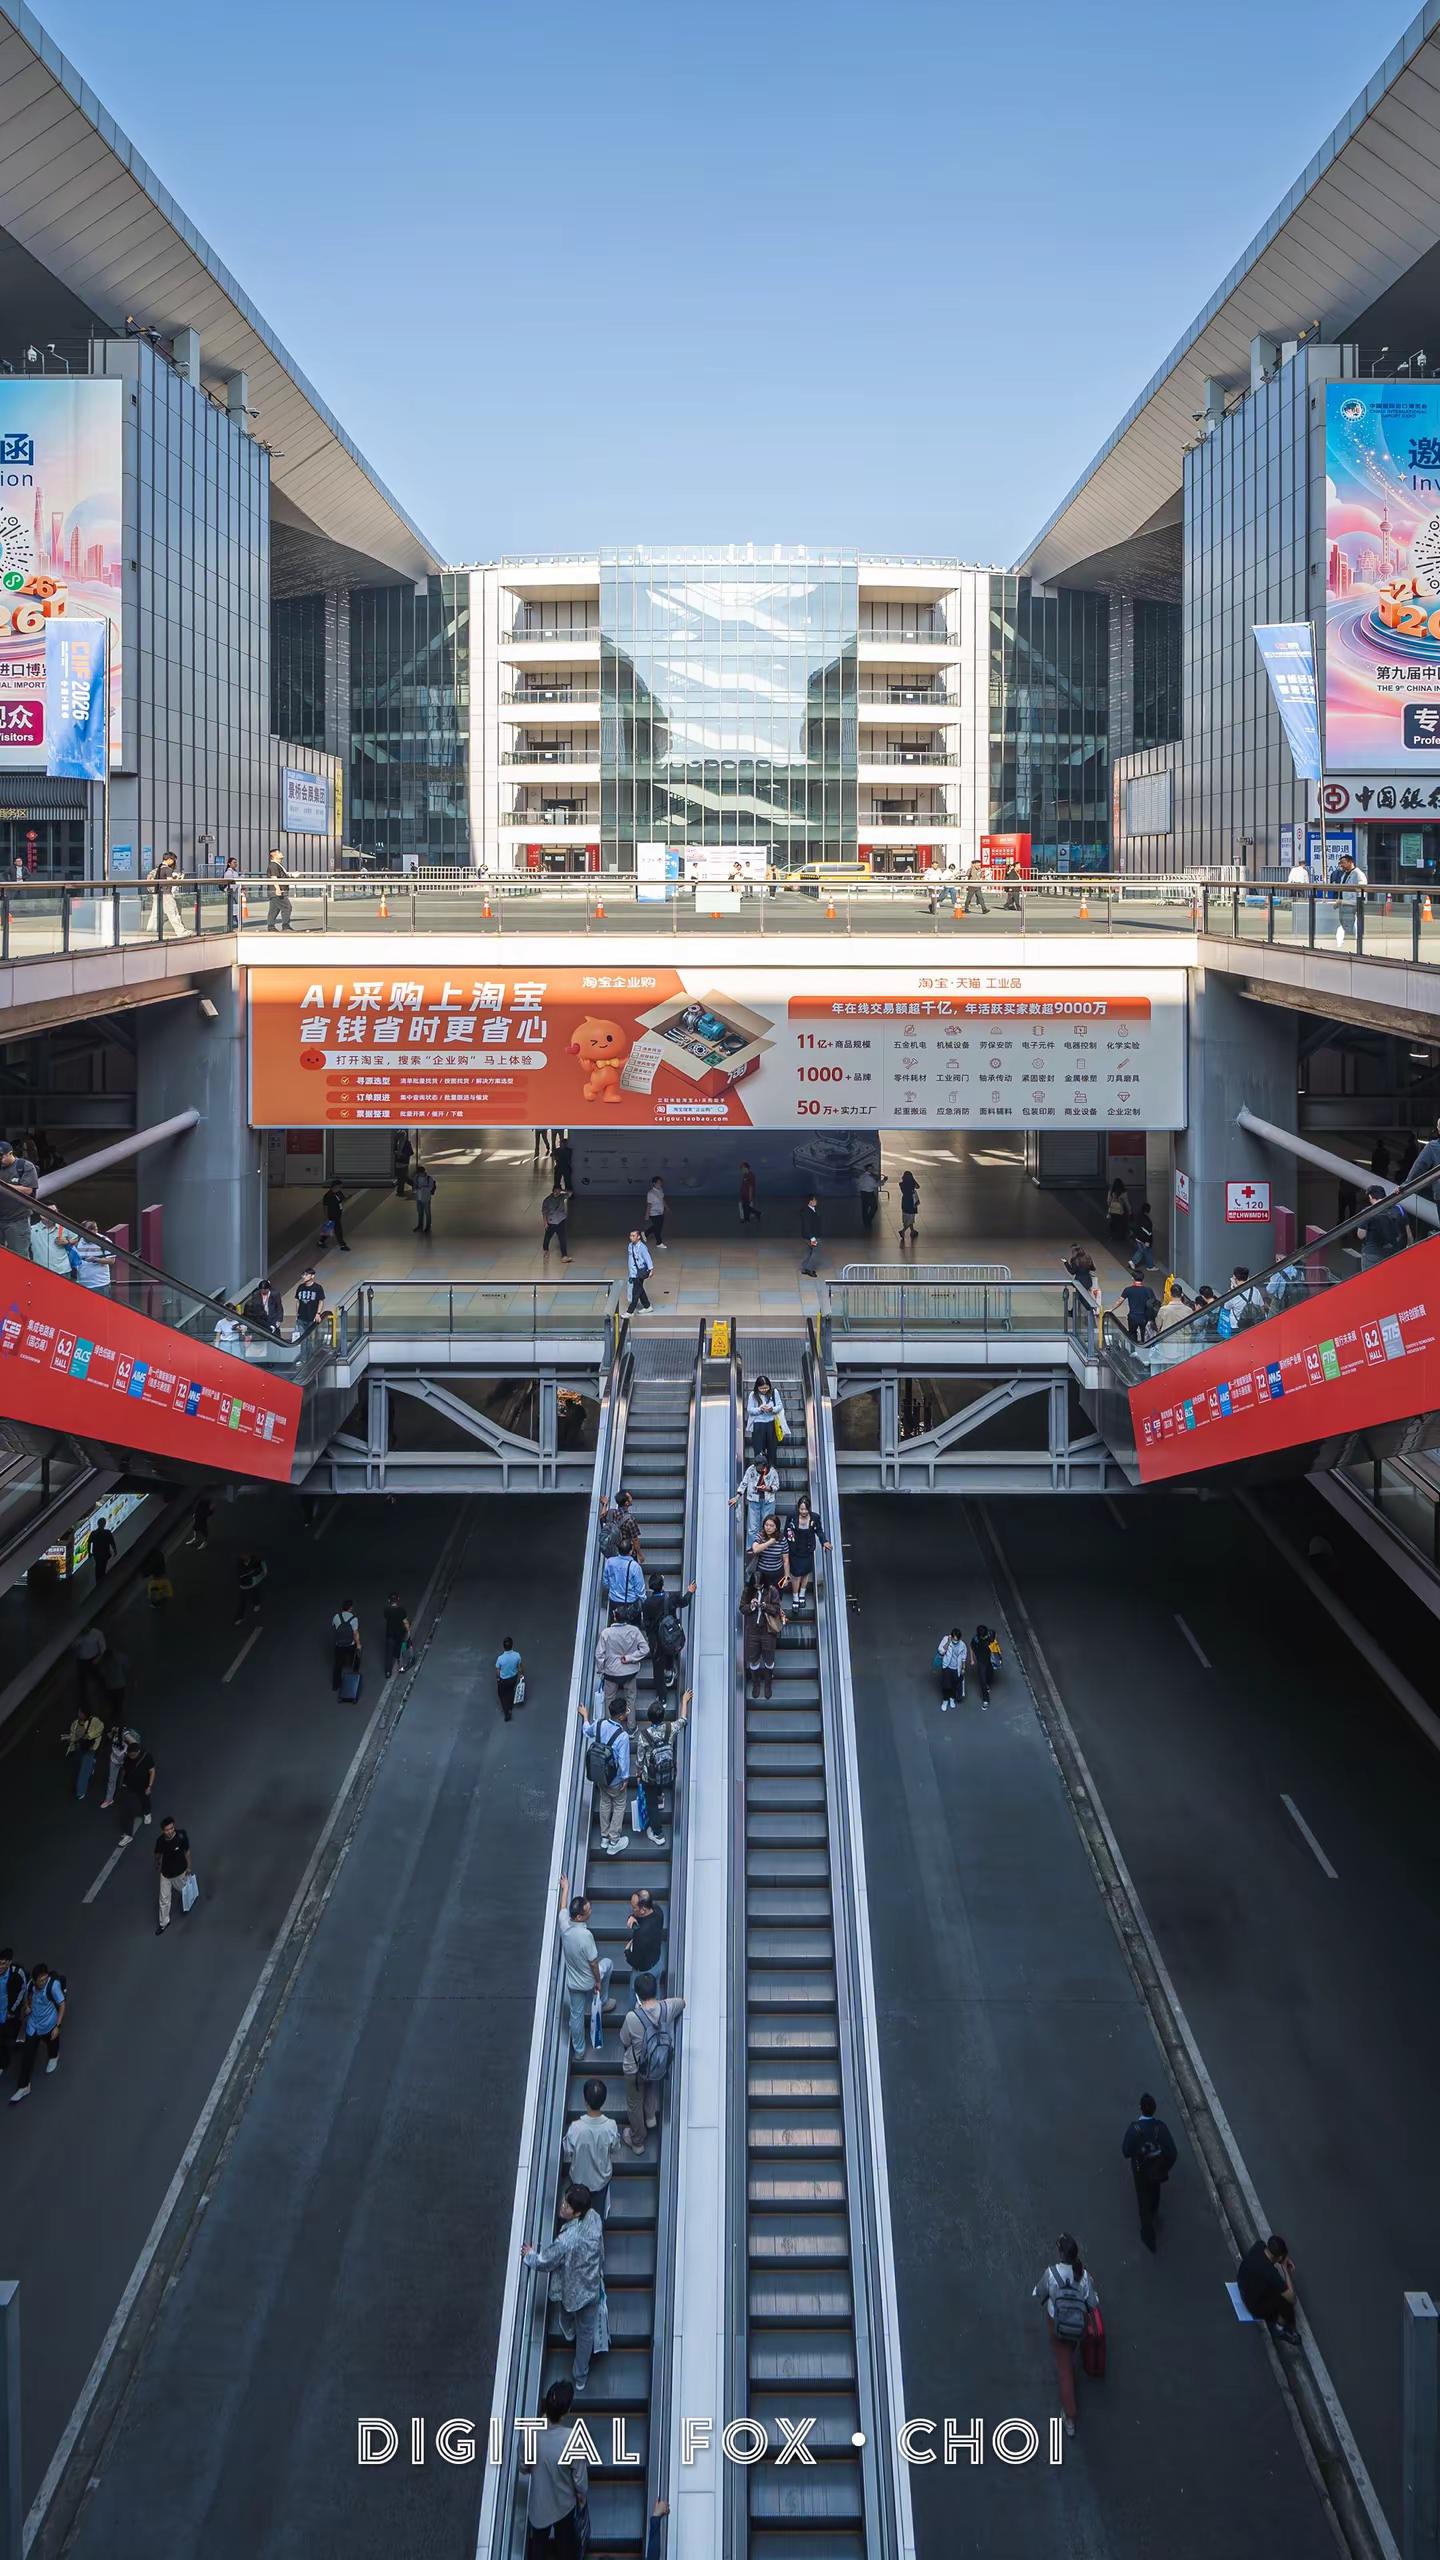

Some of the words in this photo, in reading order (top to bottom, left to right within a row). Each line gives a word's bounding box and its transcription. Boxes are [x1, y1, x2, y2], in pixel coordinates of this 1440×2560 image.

[0, 434, 34, 466] 函
[1408, 437, 1440, 469] 邀
[1377, 666, 1440, 680] 第九届中
[1377, 684, 1393, 692] THE
[1406, 684, 1432, 692] CHINA
[72, 681, 90, 721] 2026
[1414, 708, 1440, 732] 专
[0, 732, 34, 742] isitors
[582, 976, 656, 988] 淘宝企业购
[918, 977, 981, 990] 淘宝·天猫
[986, 978, 1022, 989] 工业品
[300, 981, 548, 1012] AI采购上淘宝
[832, 1000, 1108, 1017] 年在线交易额超千亿，年活跃买家数超9000万
[300, 1016, 548, 1044] 省钱省时更省心
[835, 1040, 872, 1049] 商品规模
[894, 1041, 927, 1049] 五金机电
[936, 1041, 970, 1049] 机械设备
[980, 1041, 1013, 1049] 劳保安防
[1022, 1041, 1056, 1049] 电子元件
[1064, 1041, 1098, 1049] 电器控制
[1106, 1041, 1140, 1049] 化学实验
[797, 1067, 852, 1082] 1000+
[854, 1073, 872, 1082] 品牌
[894, 1074, 927, 1082] 零件耗材
[936, 1074, 970, 1082] 工业阀门
[979, 1074, 1012, 1082] 轴承传动
[1022, 1074, 1055, 1082] 紧固密封
[1064, 1074, 1098, 1082] 金属橡塑
[356, 1093, 391, 1102] 订单跟进
[840, 1106, 878, 1115] 实力工厂
[894, 1108, 927, 1116] 起重搬运
[936, 1108, 970, 1116] 应急消防
[980, 1108, 1012, 1116] 面料辅料
[1022, 1108, 1056, 1116] 包装印刷
[1064, 1108, 1098, 1116] 商业设备
[1107, 1108, 1140, 1116] 企业定制
[1246, 1201, 1264, 1209] 120
[1398, 1304, 1426, 1324] 科技创新展
[1364, 1330, 1380, 1348] 8.2
[57, 1338, 72, 1357] 6.2
[54, 1356, 67, 1368] HALL
[74, 1348, 92, 1363] GLCS
[1306, 1352, 1320, 1370] 8.2
[1368, 1350, 1382, 1360] HALL
[118, 1361, 130, 1378] 6.2
[116, 1378, 126, 1388] HALL
[1256, 1374, 1266, 1390] 7.2
[1311, 1372, 1321, 1382] HALL
[178, 1383, 188, 1398] 7.2
[221, 1399, 231, 1413] 8.2
[1209, 1393, 1218, 1408] 6.2
